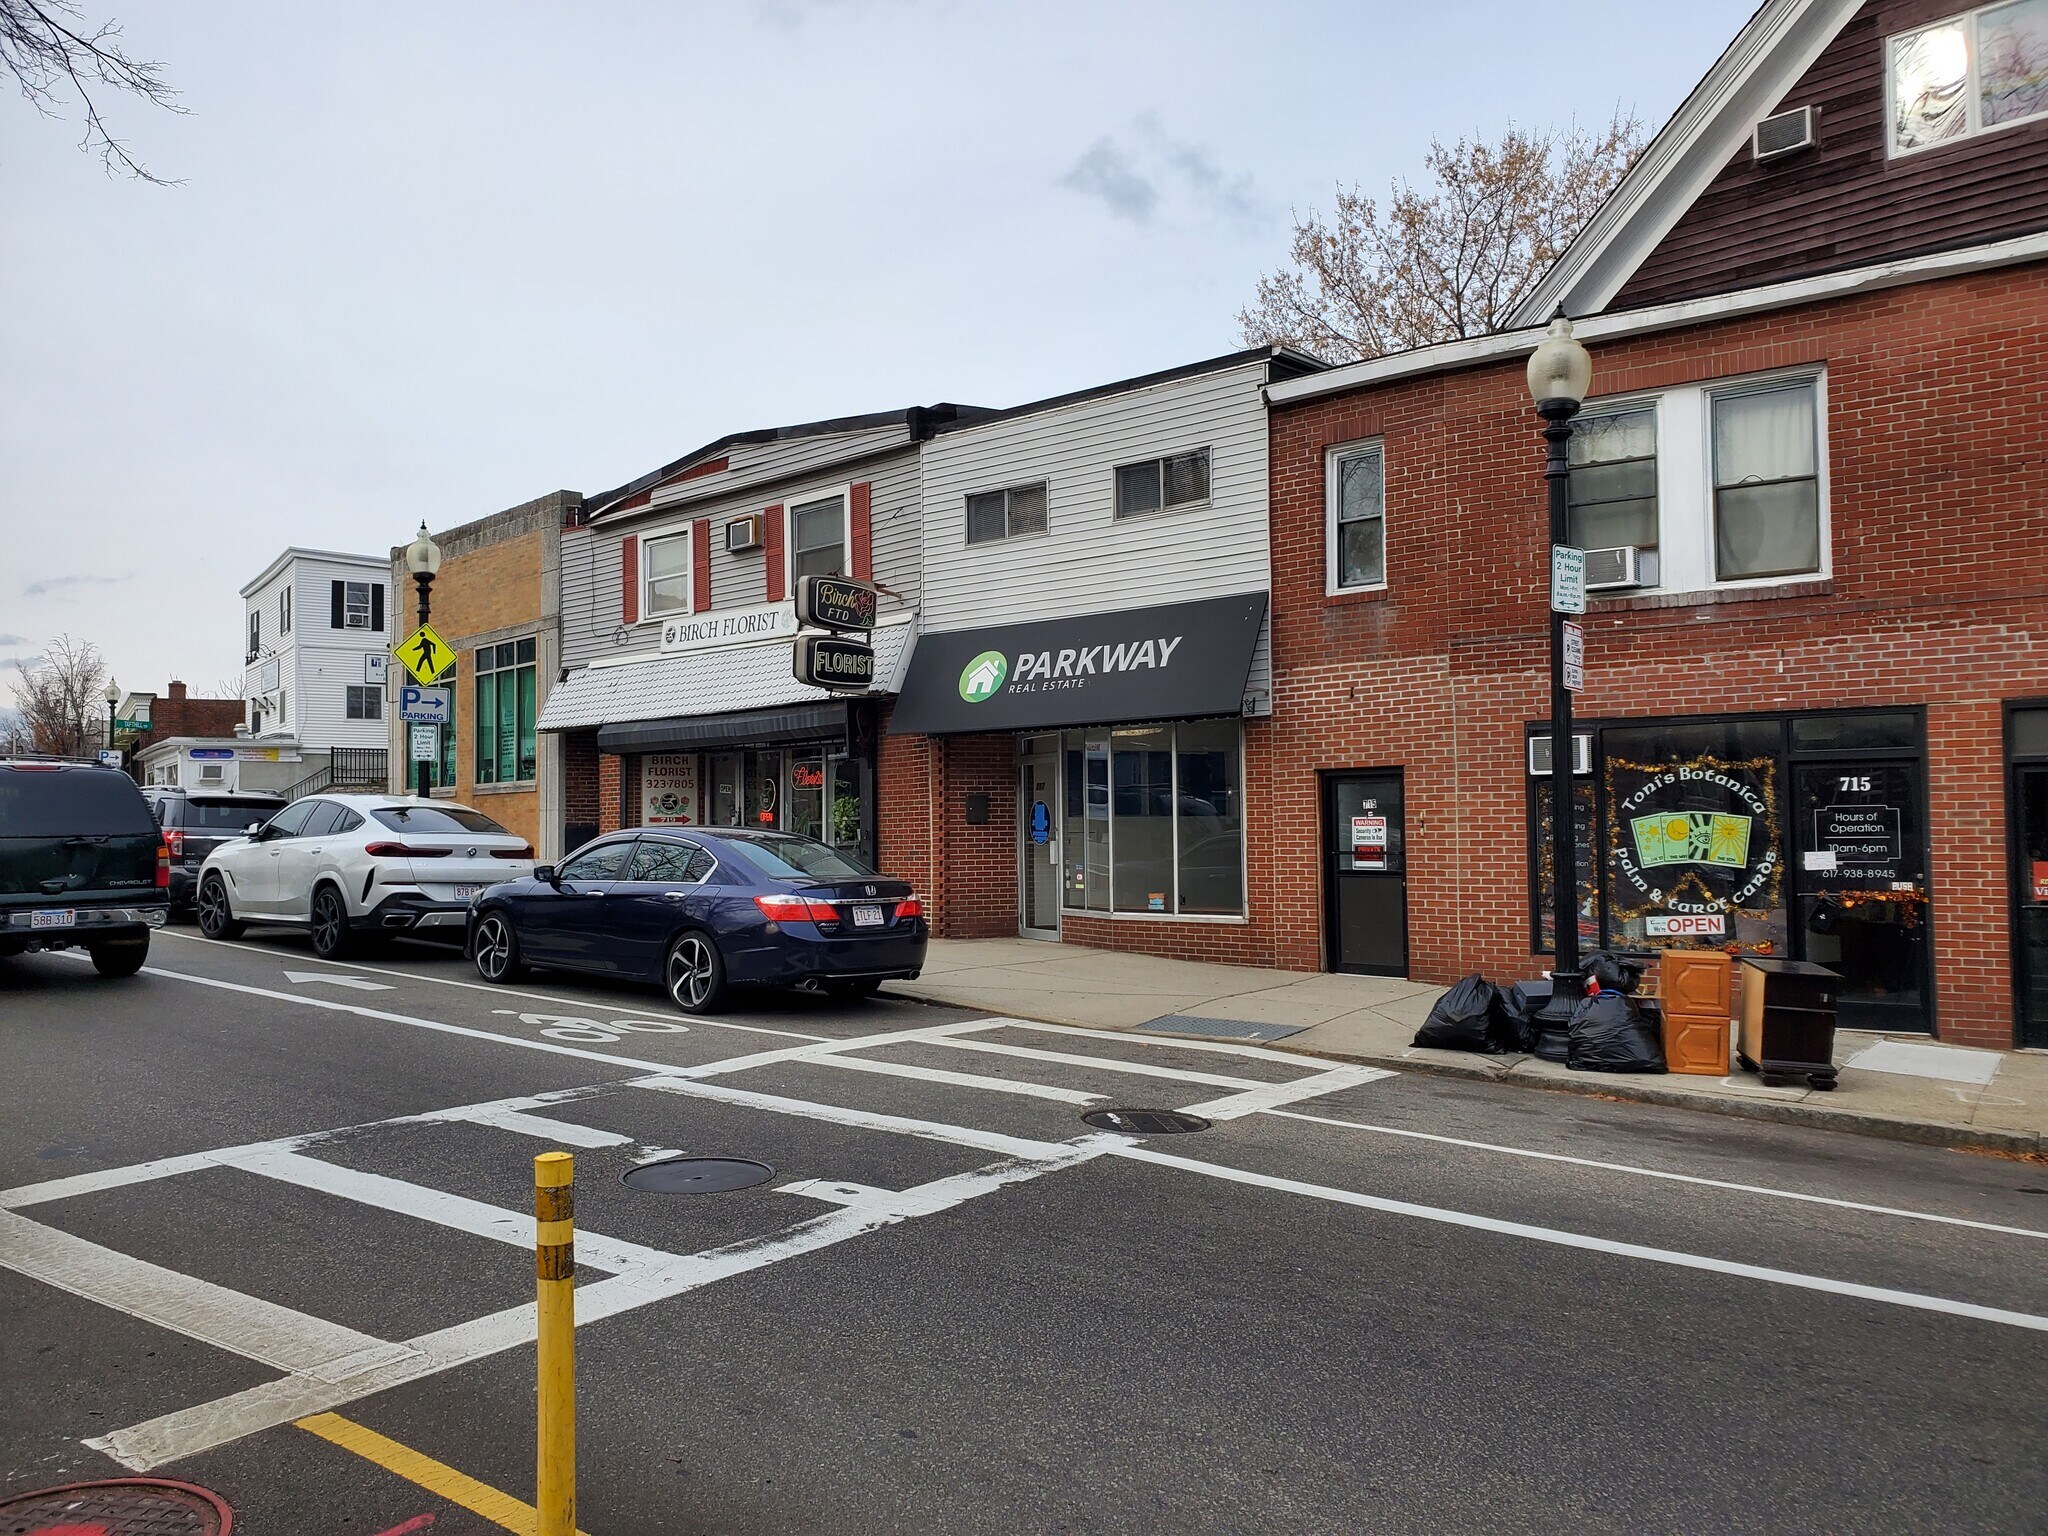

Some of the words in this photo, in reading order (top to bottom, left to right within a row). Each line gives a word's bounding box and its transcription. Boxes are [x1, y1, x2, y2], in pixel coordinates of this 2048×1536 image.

[1556, 550, 1582, 564] Parking
[1556, 562, 1562, 570] 2
[1564, 562, 1582, 572] Hour
[1560, 574, 1578, 584] Limit
[820, 584, 856, 609] Birch
[827, 608, 849, 621] FTD
[678, 620, 718, 642] BIRCH
[723, 611, 780, 636] FLORIST
[816, 652, 874, 675] FLORIST
[1012, 636, 1182, 682] PARKWAY
[1008, 683, 1036, 694] REAL
[1042, 678, 1085, 691] ESTATE
[402, 688, 421, 711] P
[402, 712, 444, 720] PARKING
[652, 756, 689, 765] BIRCH
[648, 767, 692, 776] FLORIST
[1840, 776, 1872, 792] 715
[1621, 772, 1675, 812] Toni's
[1679, 766, 1766, 814] Botanica
[1362, 799, 1377, 810] 715
[760, 812, 774, 822] OPEN
[1835, 813, 1864, 822] Hours
[1866, 812, 1878, 821] of
[1830, 823, 1885, 834] Operation
[1828, 844, 1888, 854] 10am-6pm
[1822, 869, 1896, 878] 617-938-8945
[1614, 847, 1648, 893] palm
[1649, 888, 1662, 904] &
[1667, 896, 1730, 914] tarot
[1732, 851, 1777, 904] cards
[456, 888, 470, 896] 87B
[34, 916, 52, 926] 58B
[54, 914, 72, 925] 310
[855, 910, 871, 921] 1TLF
[873, 910, 882, 920] 21
[1667, 918, 1721, 932] OPEN
